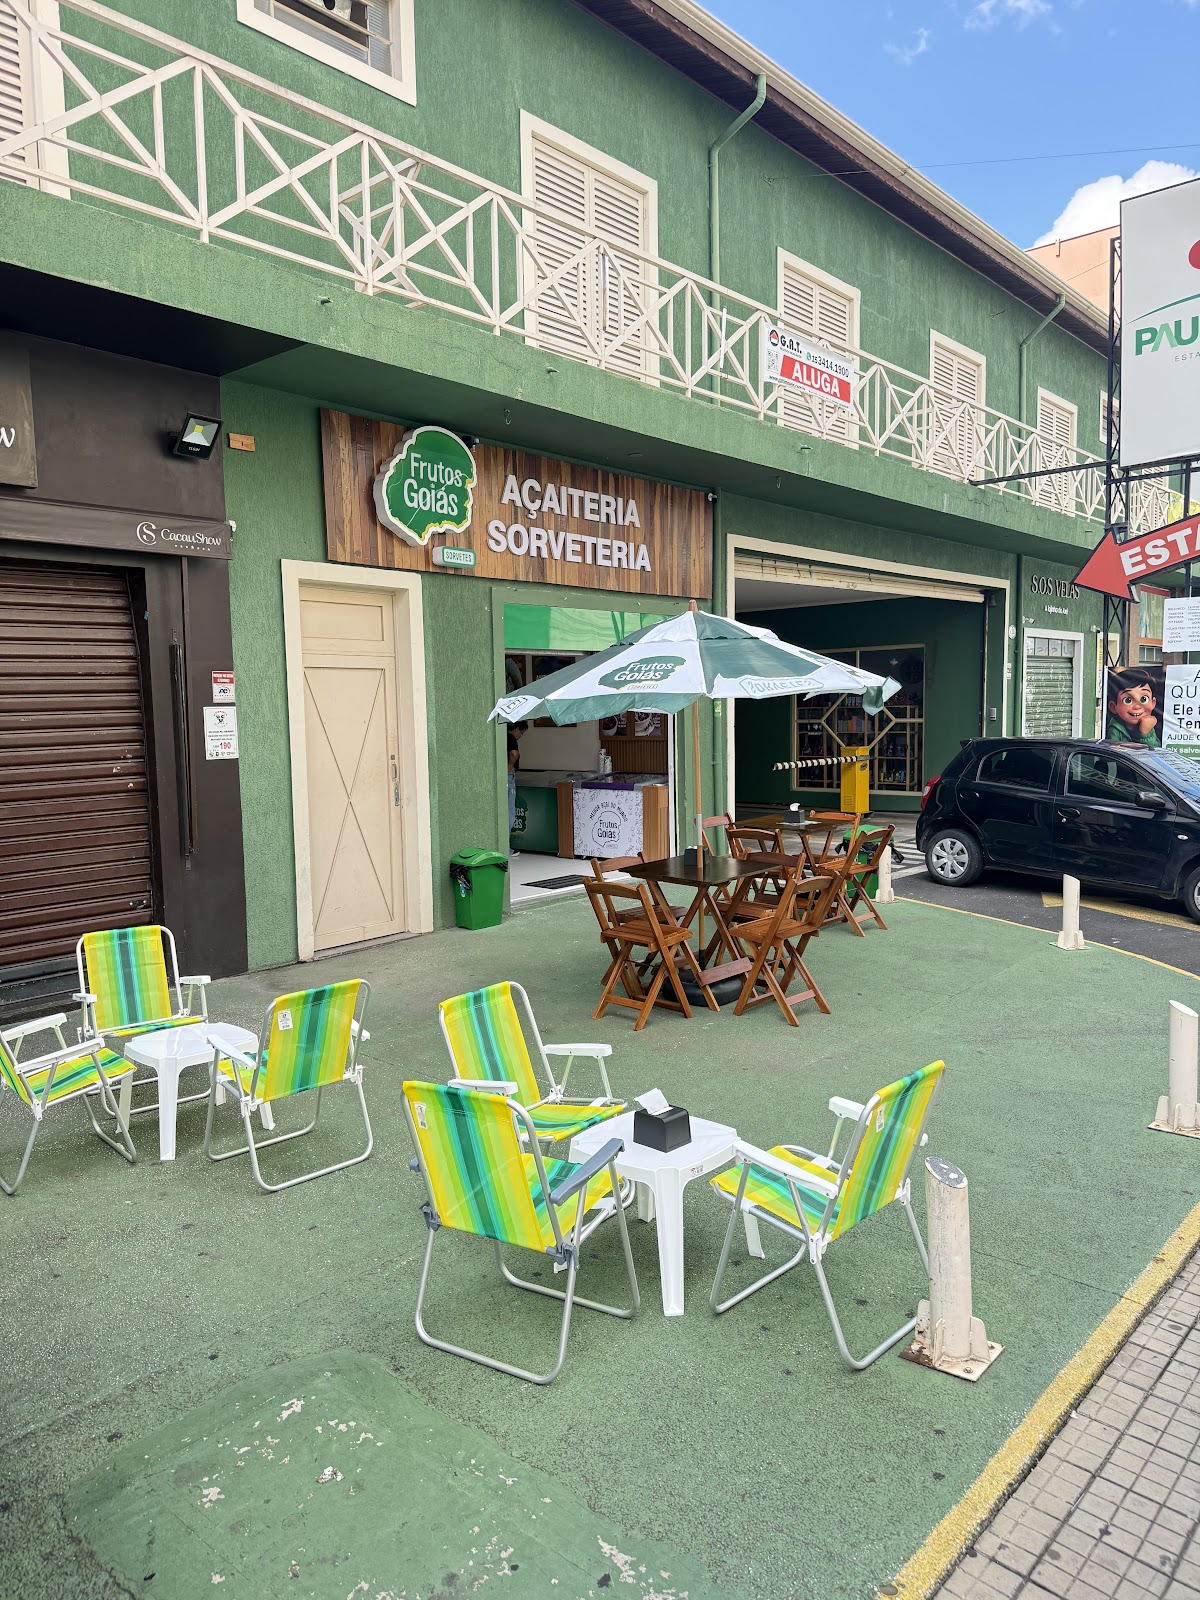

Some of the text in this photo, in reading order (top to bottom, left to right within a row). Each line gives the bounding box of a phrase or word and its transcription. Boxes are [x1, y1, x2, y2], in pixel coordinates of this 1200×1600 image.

[792, 361, 840, 398] ALUGA
[410, 452, 463, 488] Frutos
[403, 478, 458, 516] Goiás
[501, 474, 641, 529] AÇAITERIA
[487, 519, 652, 572] SORVETERIA
[1119, 523, 1200, 577] EST
[445, 551, 472, 563] SORVETES
[1055, 579, 1080, 600] VELAS
[627, 662, 674, 672] Frutos
[614, 669, 664, 681] Goiás
[1171, 685, 1197, 699] QU
[1173, 704, 1193, 715] Ele
[1167, 733, 1195, 741] AJUDE
[219, 741, 231, 750] 190
[1179, 746, 1200, 754] salve
[599, 819, 618, 829] Frutos
[597, 828, 617, 839] Goiás
